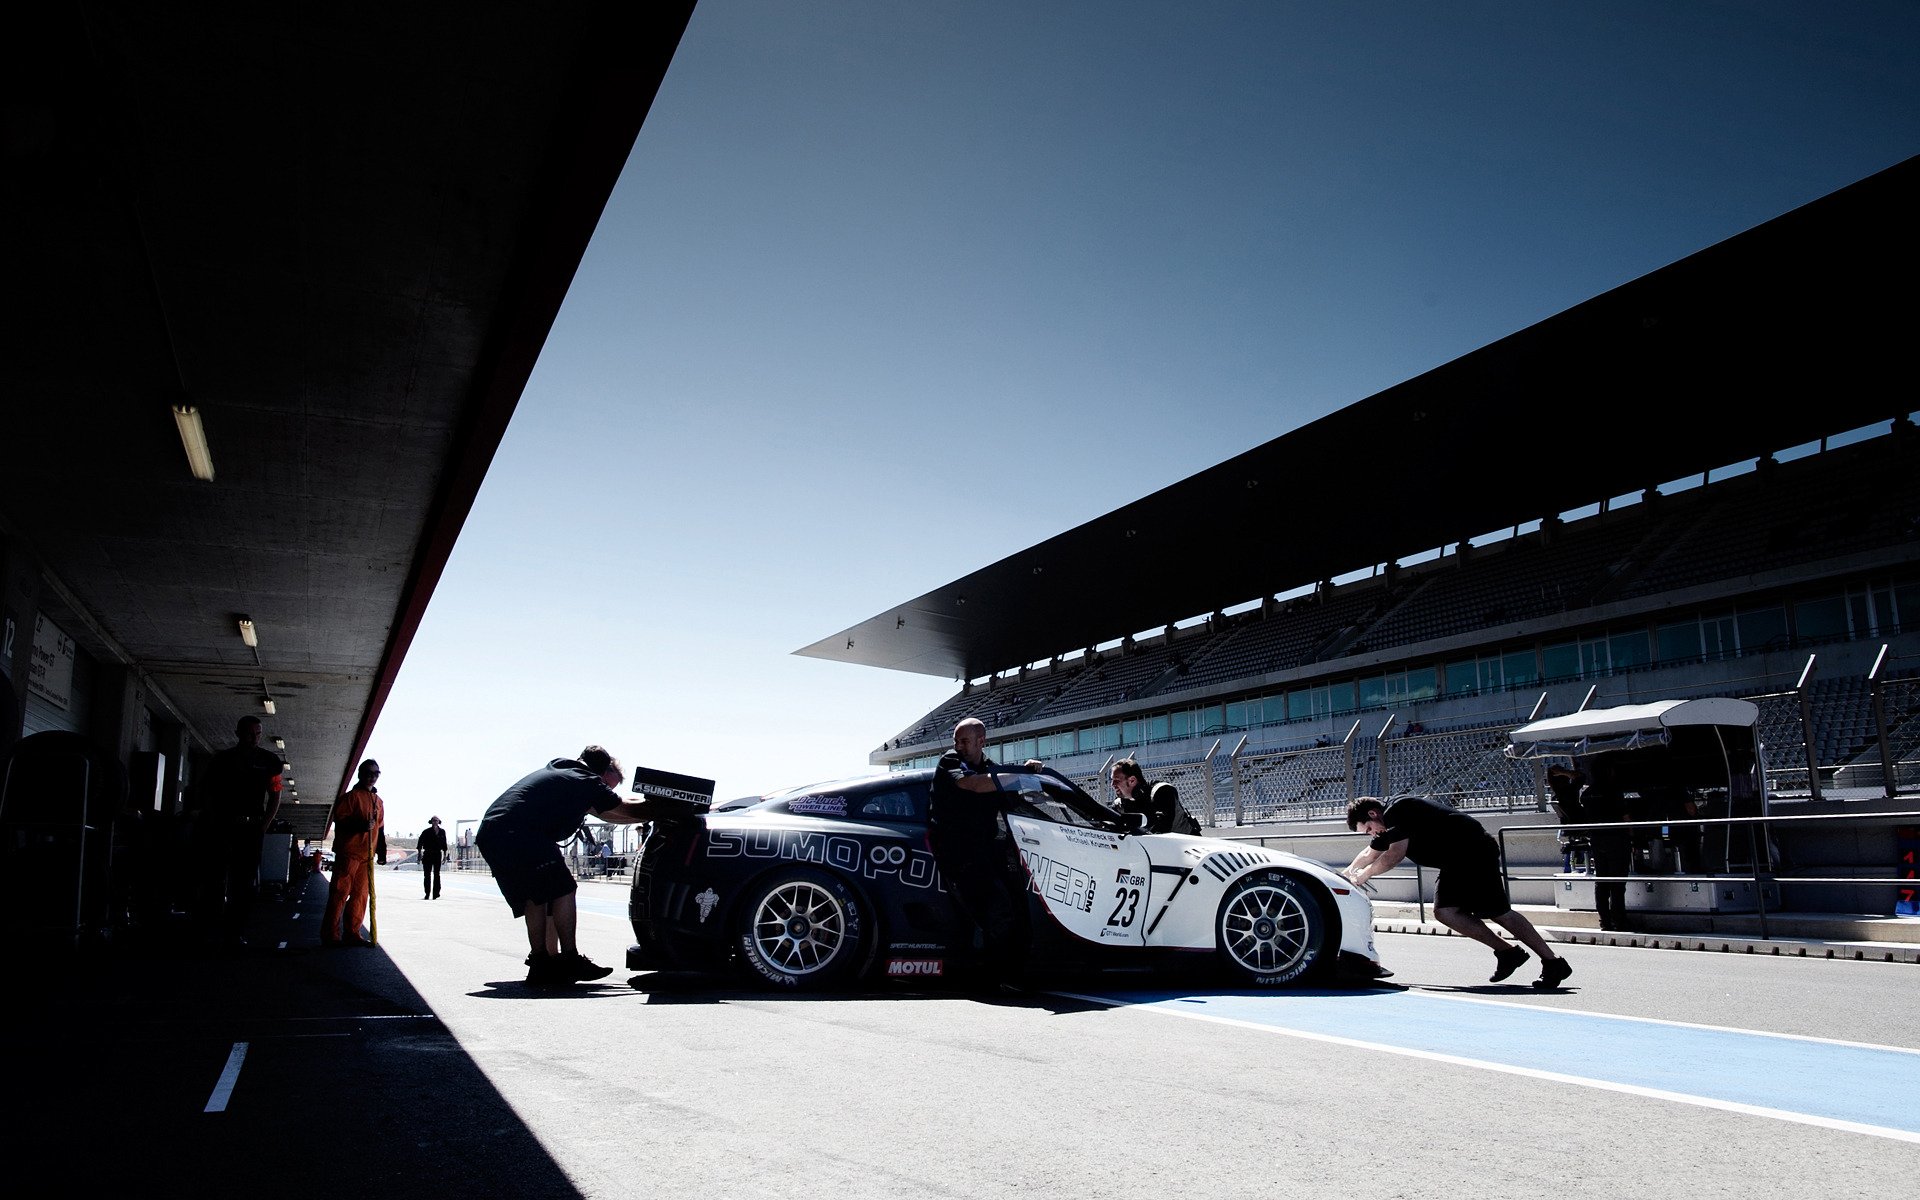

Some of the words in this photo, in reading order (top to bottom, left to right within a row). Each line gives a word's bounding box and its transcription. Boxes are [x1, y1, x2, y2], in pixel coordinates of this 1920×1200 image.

[4, 617, 16, 659] 12
[1059, 826, 1077, 837] Peter
[1077, 829, 1108, 841] Dumbreck
[1066, 835, 1089, 846] Michael
[1090, 839, 1111, 849] Krumm
[1129, 874, 1146, 887] GBR
[1107, 887, 1140, 927] 23
[742, 936, 783, 983] MICHELIN
[887, 961, 941, 974] MOTUL
[1255, 960, 1308, 985] MICHELIN
